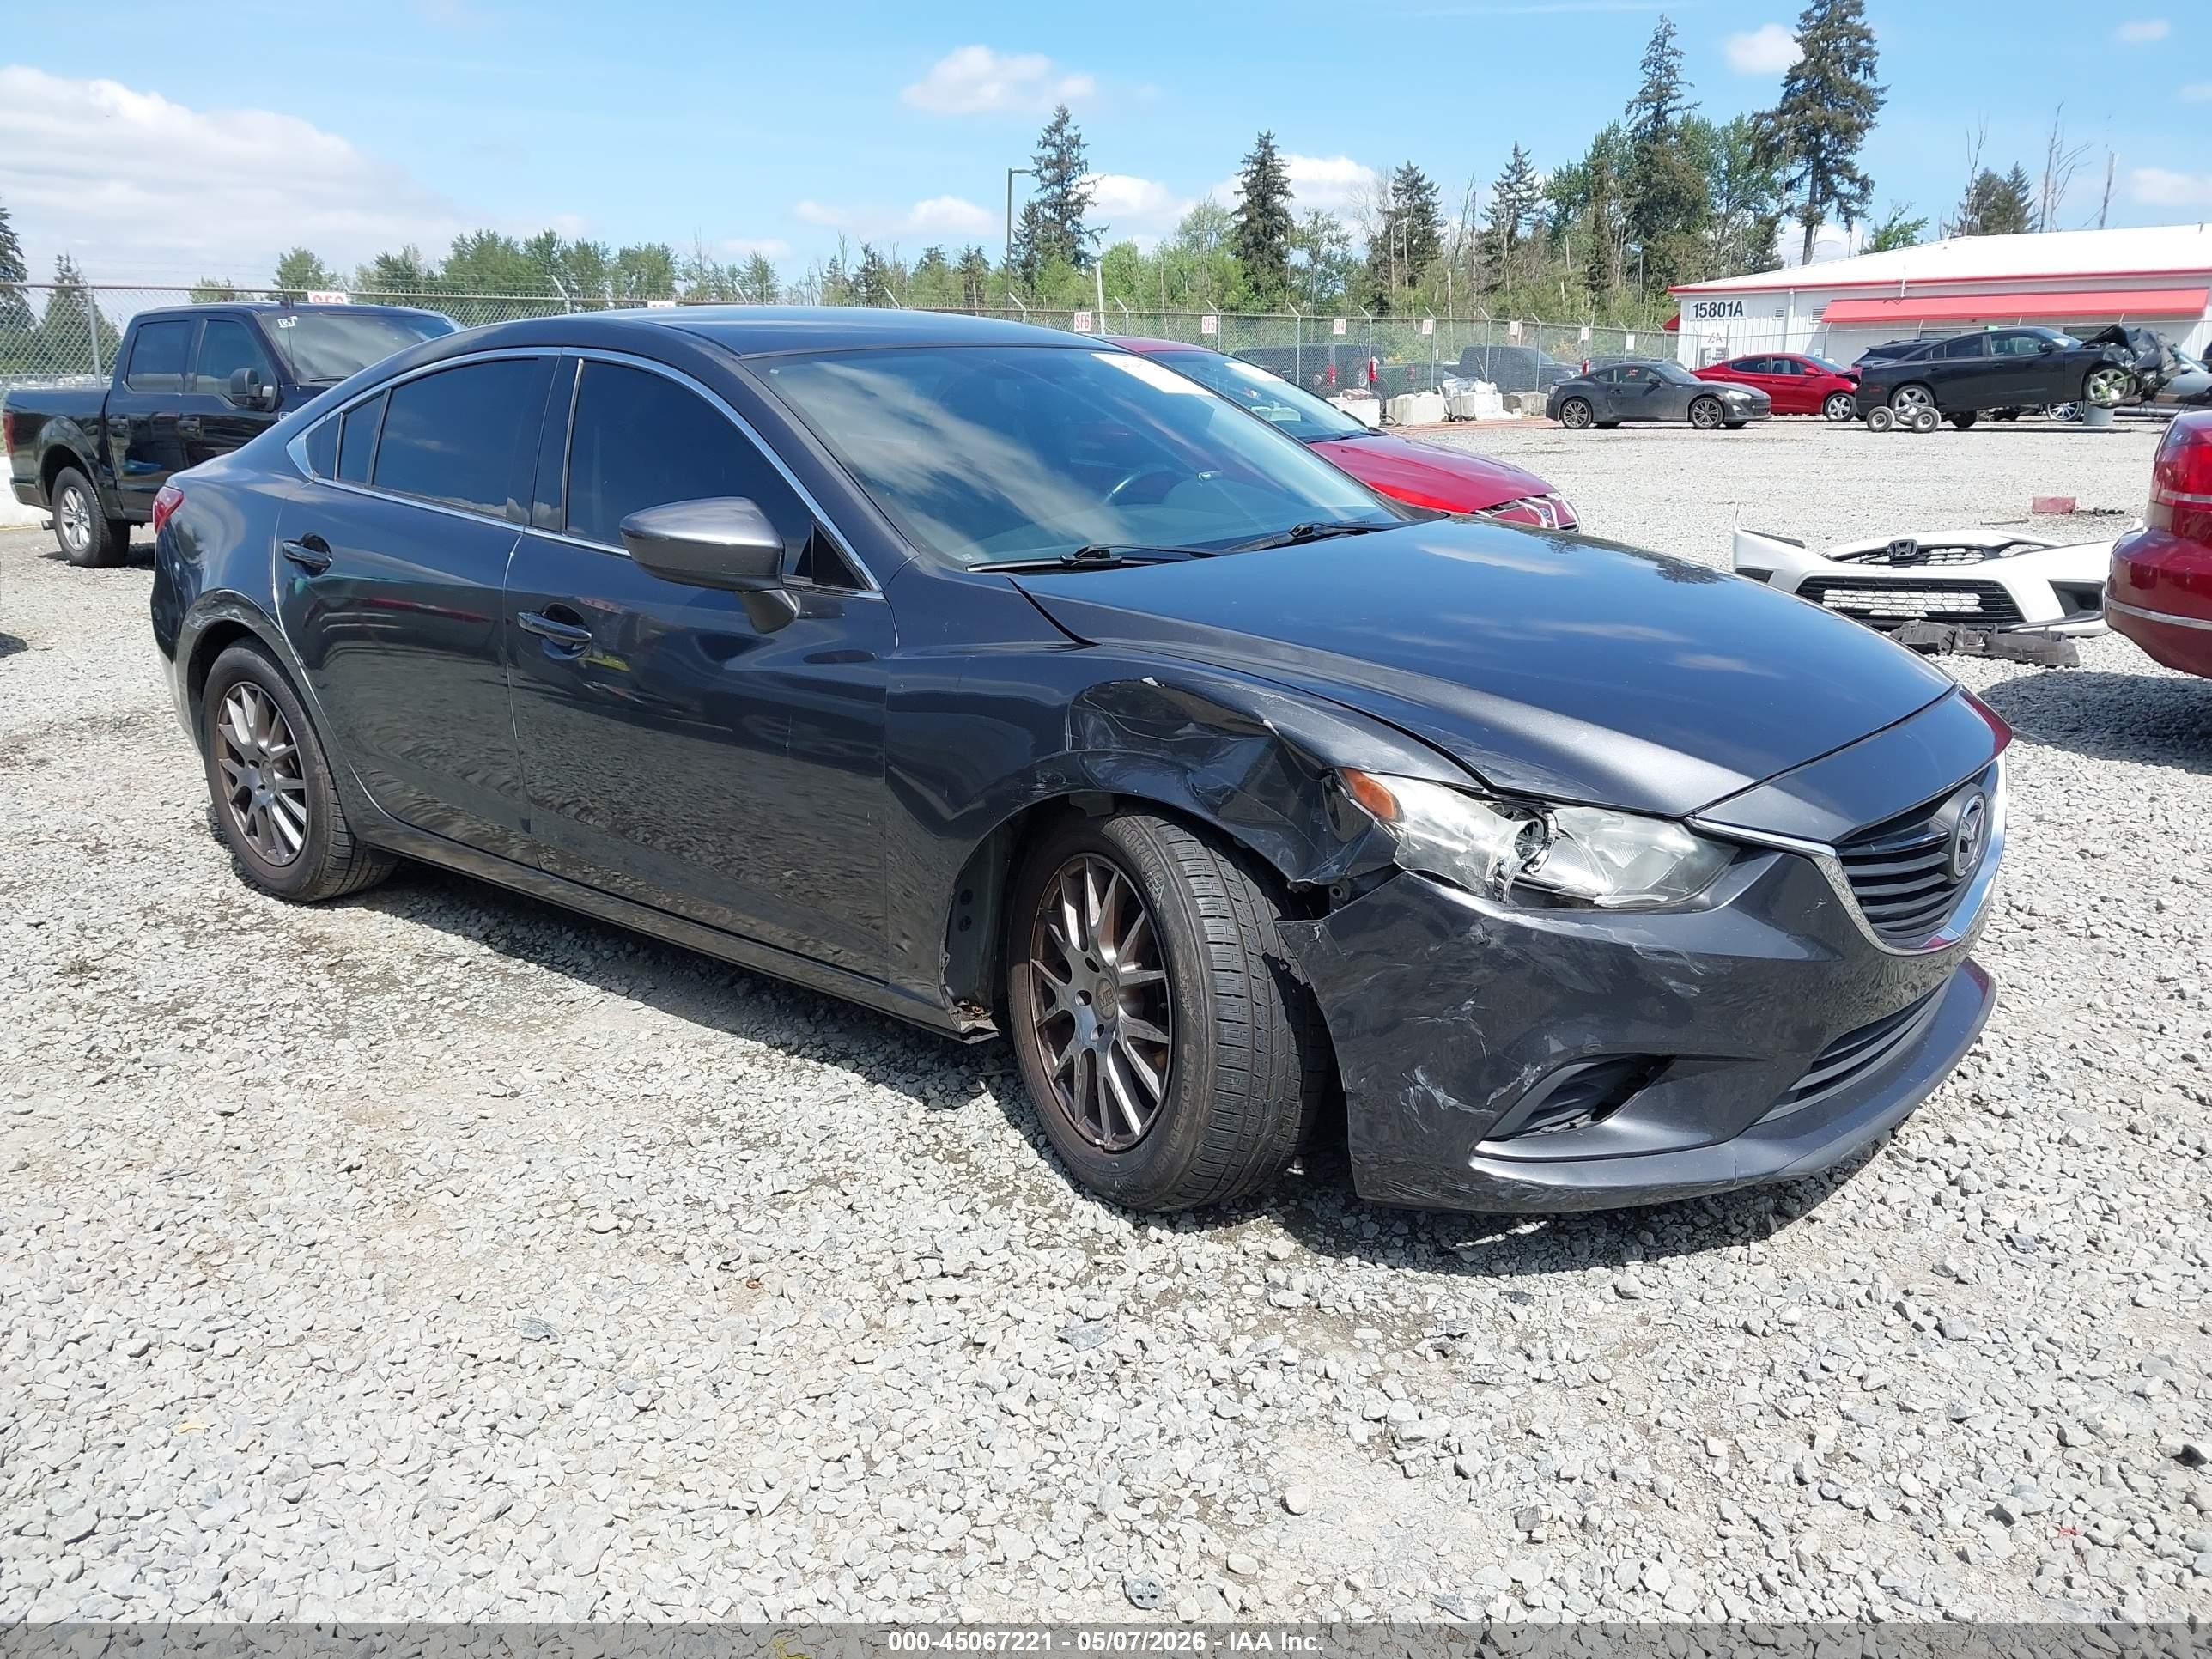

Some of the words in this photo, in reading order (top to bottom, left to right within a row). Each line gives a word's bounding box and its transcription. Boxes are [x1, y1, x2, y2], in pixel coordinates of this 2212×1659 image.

[1692, 301, 1744, 319] 15801A
[1075, 313, 1090, 330] SF6
[1203, 317, 1216, 331] SF5
